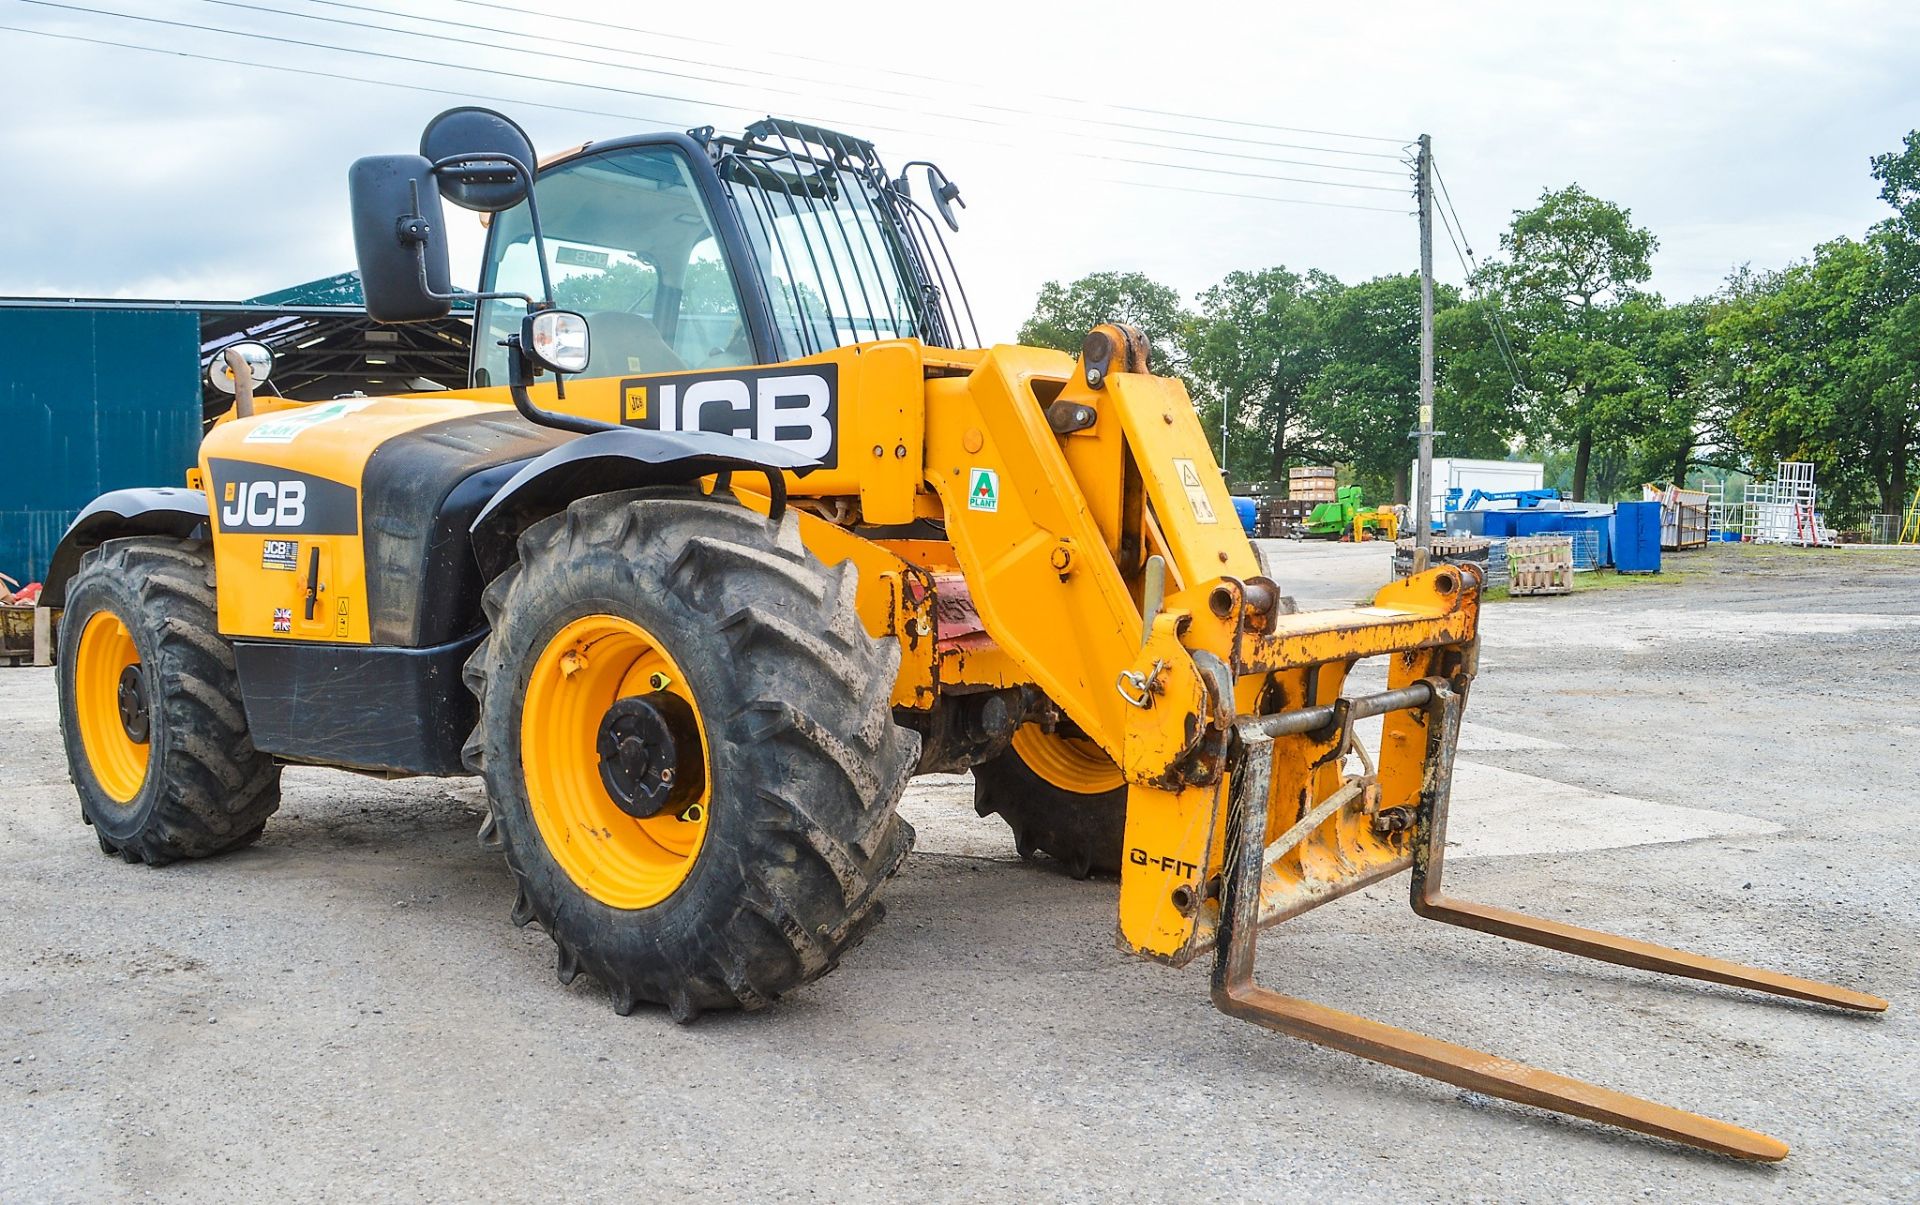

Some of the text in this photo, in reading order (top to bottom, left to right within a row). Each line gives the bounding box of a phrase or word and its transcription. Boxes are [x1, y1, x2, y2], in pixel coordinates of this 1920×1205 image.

[223, 481, 306, 526] JCB
[970, 498, 996, 507] PLANT
[264, 541, 286, 555] JCB
[1130, 848, 1197, 879] Q-FIT
